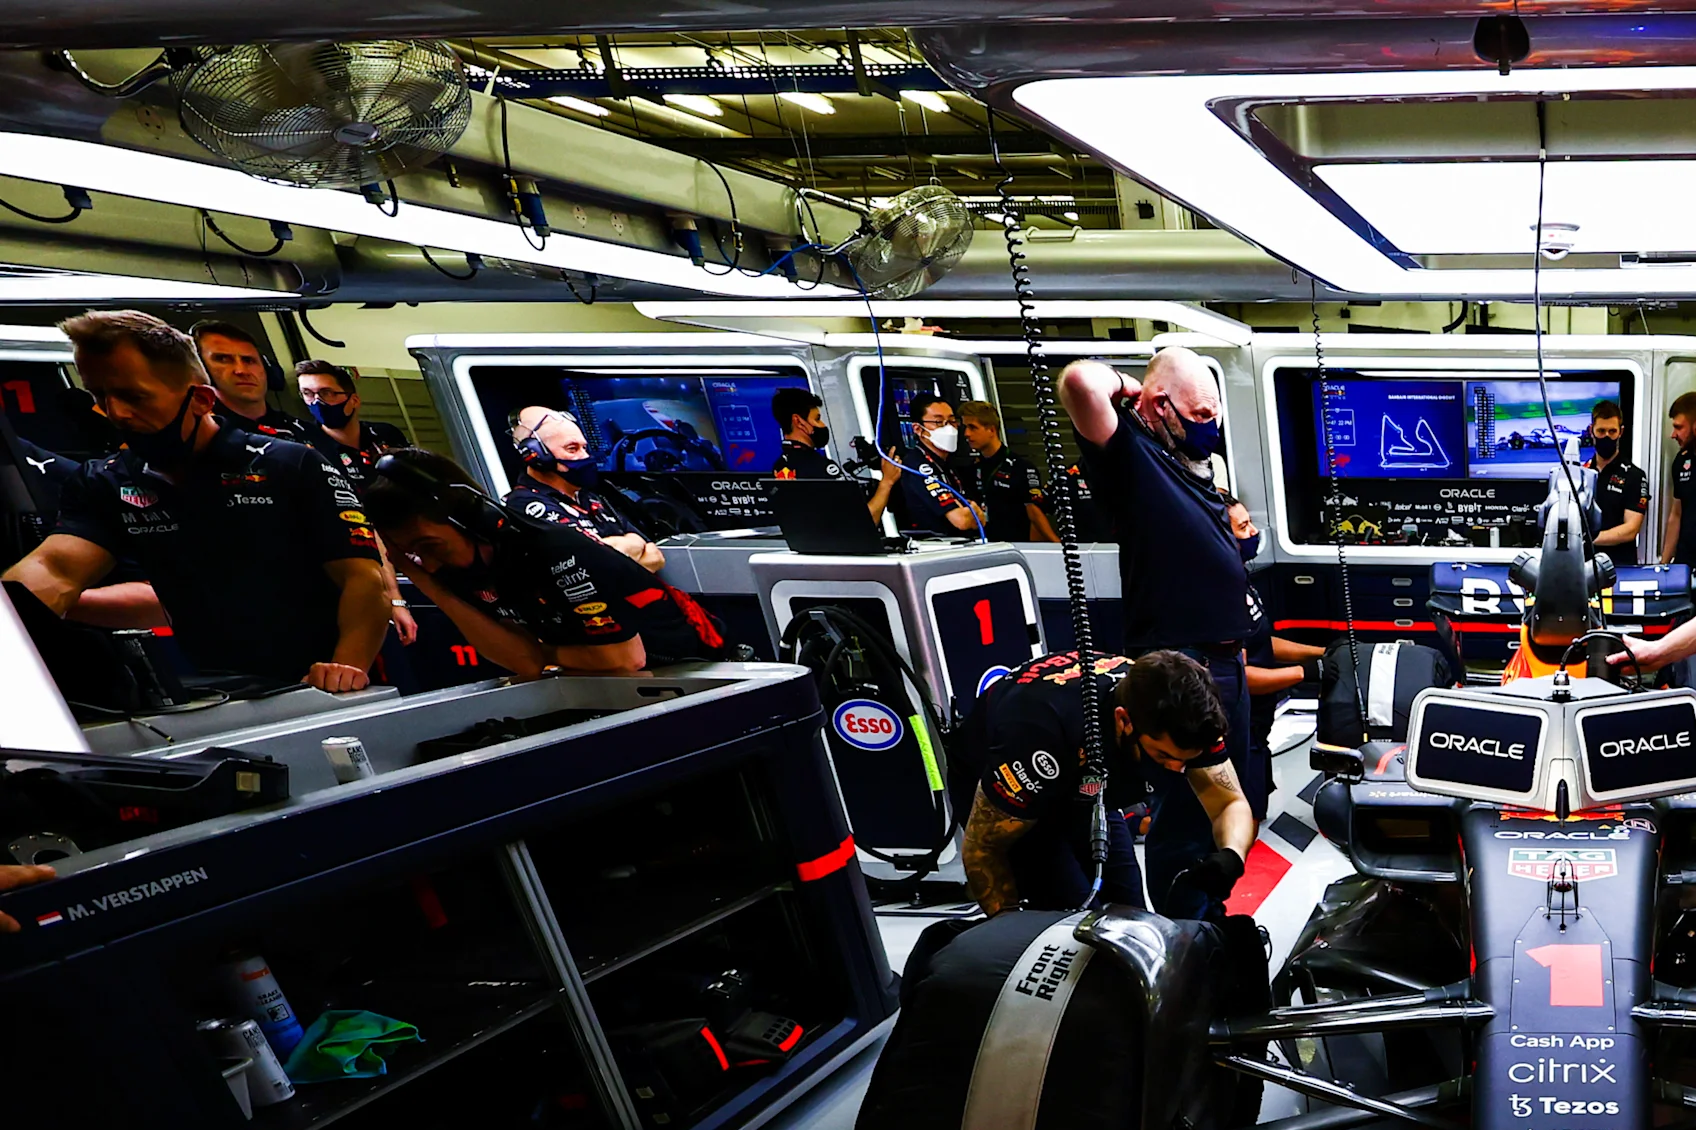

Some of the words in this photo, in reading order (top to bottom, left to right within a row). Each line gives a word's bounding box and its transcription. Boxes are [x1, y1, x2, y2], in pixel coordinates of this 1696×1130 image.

[711, 481, 763, 490] ORACLE
[1440, 489, 1495, 498] ORACLE
[234, 494, 274, 505] Tezos
[1458, 502, 1482, 513] BYBIT
[121, 512, 160, 524] Mbil
[128, 524, 179, 535] ORACLE
[551, 555, 576, 575] telcel
[556, 568, 590, 588] citrix
[1461, 577, 1658, 615] BIT
[973, 599, 995, 645] 1
[450, 645, 479, 666] 11
[845, 713, 892, 734] Esso
[1429, 732, 1526, 760] ORACLE
[1599, 731, 1692, 758] ORACLE
[1037, 755, 1055, 775] Esso
[1012, 761, 1039, 791] Claro
[1494, 832, 1631, 840] ORACLE
[1519, 851, 1606, 860] TAG
[67, 904, 95, 921] M.
[92, 867, 209, 911] VERSTAPPEN
[1015, 944, 1060, 996] Front
[1035, 949, 1079, 1001] Right
[1525, 944, 1604, 1007] 1
[1510, 1035, 1564, 1048] Cash
[1570, 1035, 1615, 1050] App
[1508, 1058, 1617, 1084] citrix
[1539, 1097, 1620, 1114] Tezos
